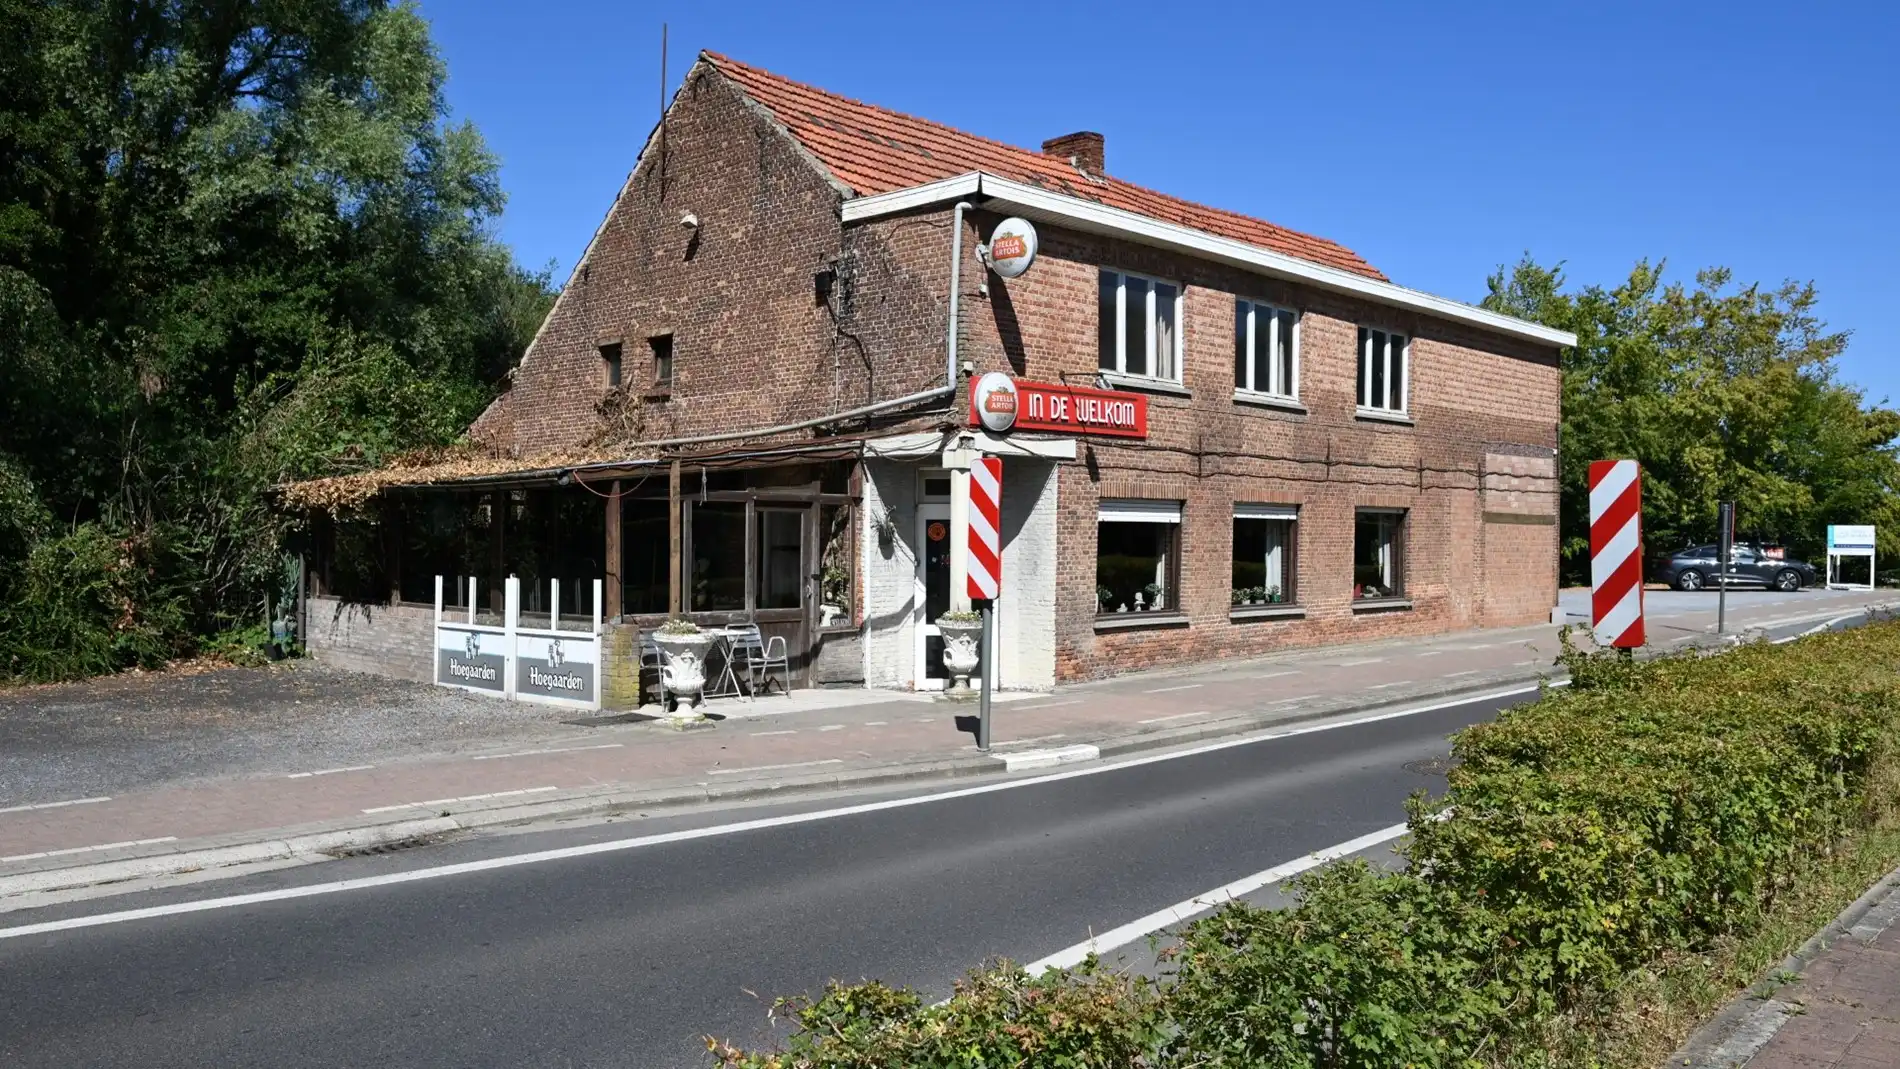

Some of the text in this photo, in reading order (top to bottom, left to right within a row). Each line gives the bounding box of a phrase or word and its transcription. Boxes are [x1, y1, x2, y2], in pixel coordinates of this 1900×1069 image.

[1028, 393, 1134, 425] IN DE WELKOM
[449, 658, 496, 681] Hoegaarden
[529, 667, 583, 691] Hoegaarden
